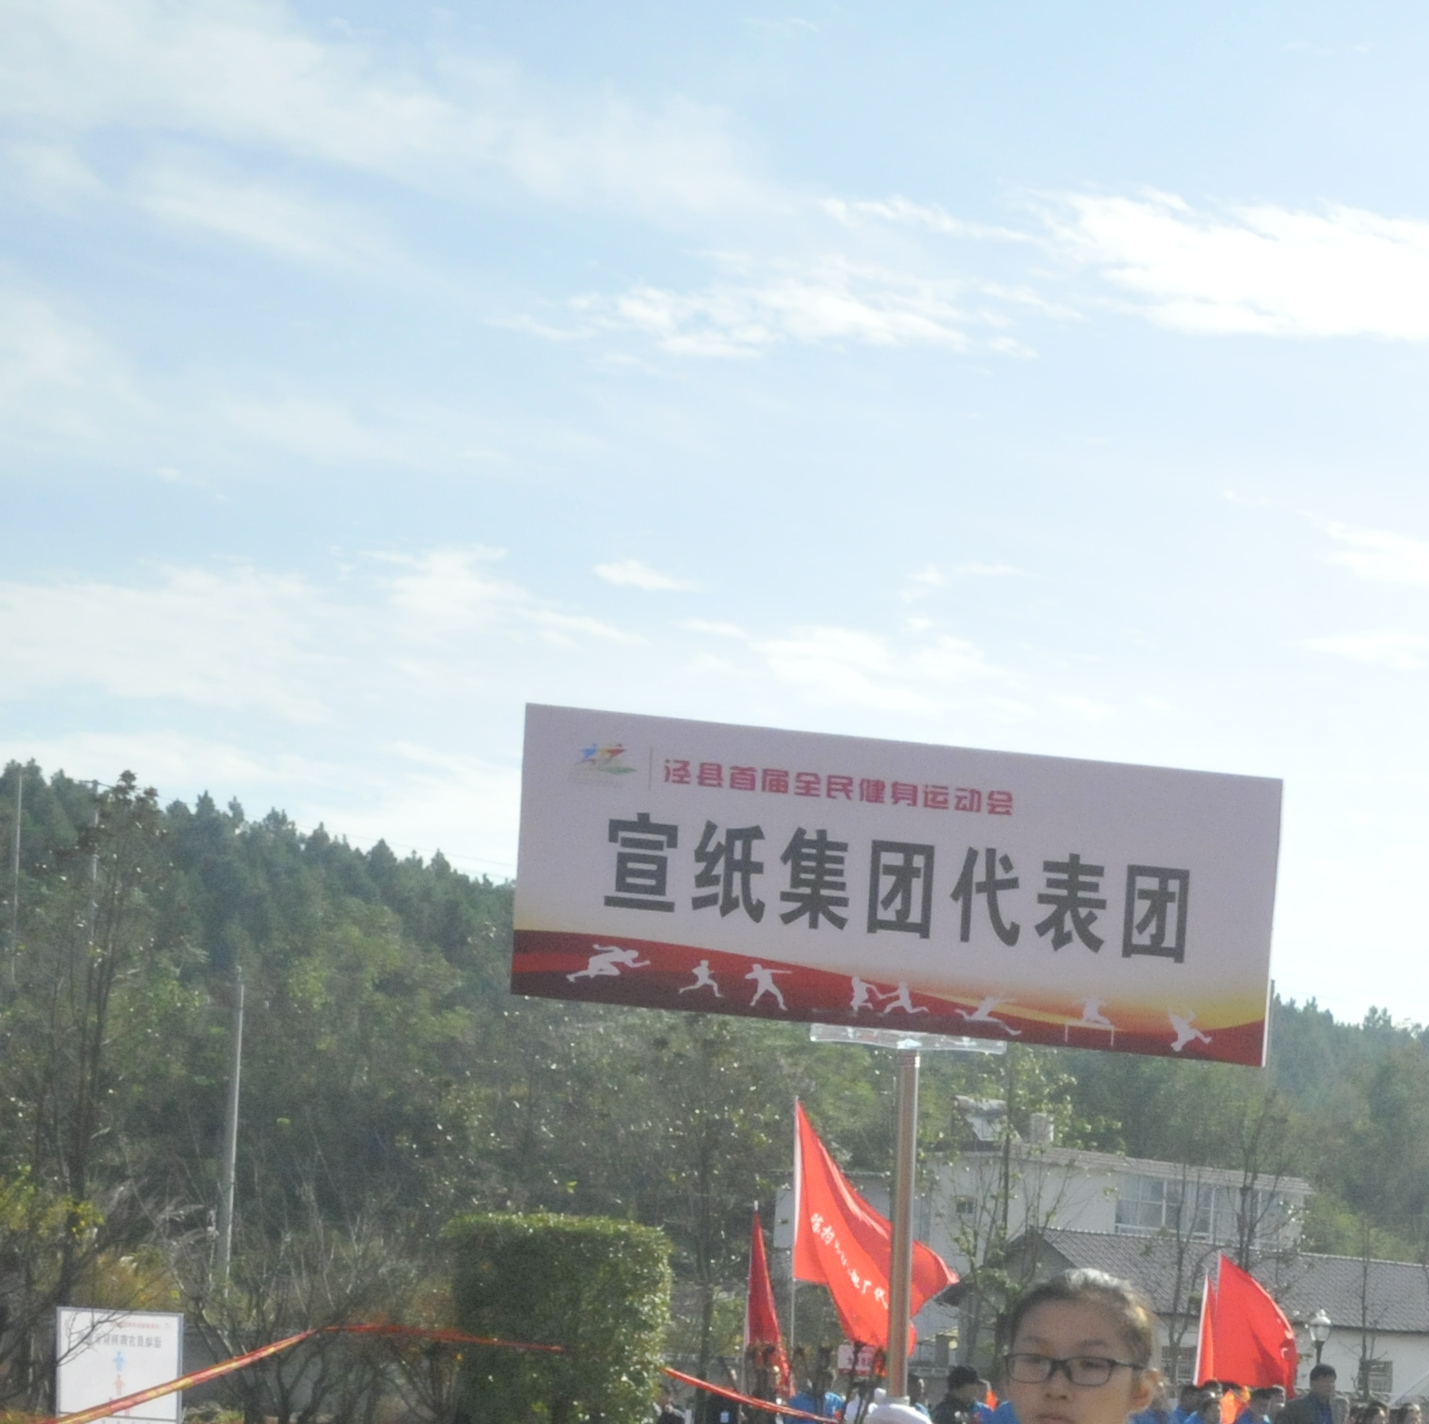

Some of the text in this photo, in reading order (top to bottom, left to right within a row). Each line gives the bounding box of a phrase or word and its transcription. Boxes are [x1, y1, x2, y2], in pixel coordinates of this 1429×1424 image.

[662, 758, 1014, 817] 泾县首届全民健身运动会
[602, 812, 1191, 964] 宣纸集团代表团
